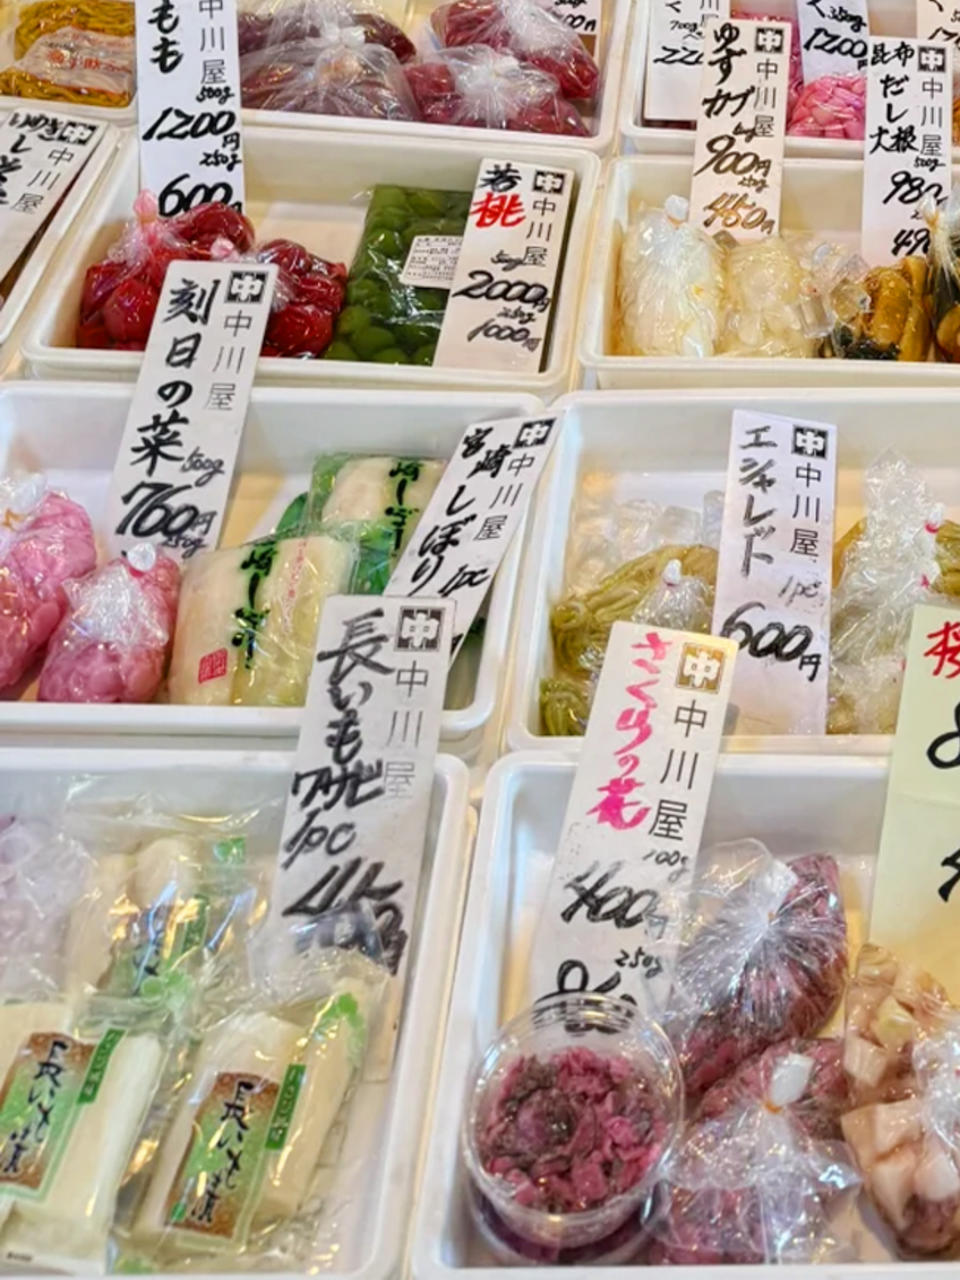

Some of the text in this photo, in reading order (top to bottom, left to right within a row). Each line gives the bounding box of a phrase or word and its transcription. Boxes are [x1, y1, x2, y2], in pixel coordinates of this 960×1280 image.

[195, 85, 236, 105] 500g
[702, 22, 757, 119] ゆずカブ
[867, 40, 919, 155] 昆布だし大根
[141, 106, 242, 151] 1200円
[199, 150, 243, 172] 250g
[693, 135, 772, 178] 900円
[468, 163, 527, 229] 若桃
[702, 190, 776, 236] 450円
[451, 270, 552, 313] 2000円
[203, 308, 253, 412] 中川屋
[466, 318, 542, 353] 1000円
[130, 278, 222, 478] 刻日の菜
[180, 445, 227, 488] 500g
[473, 451, 536, 542] 中川屋
[114, 480, 218, 539] 760円
[407, 426, 514, 598] 宮崎しぼり
[788, 462, 822, 558] 中川屋
[719, 601, 822, 683] 600円
[316, 607, 397, 764] 長いも
[384, 659, 429, 801] 中川屋
[585, 631, 673, 831] さくらの花
[647, 699, 709, 842] 中川屋
[281, 806, 356, 871] 1pc
[641, 848, 692, 884] 100g
[560, 860, 669, 940] 400円
[614, 948, 666, 982] 250g
